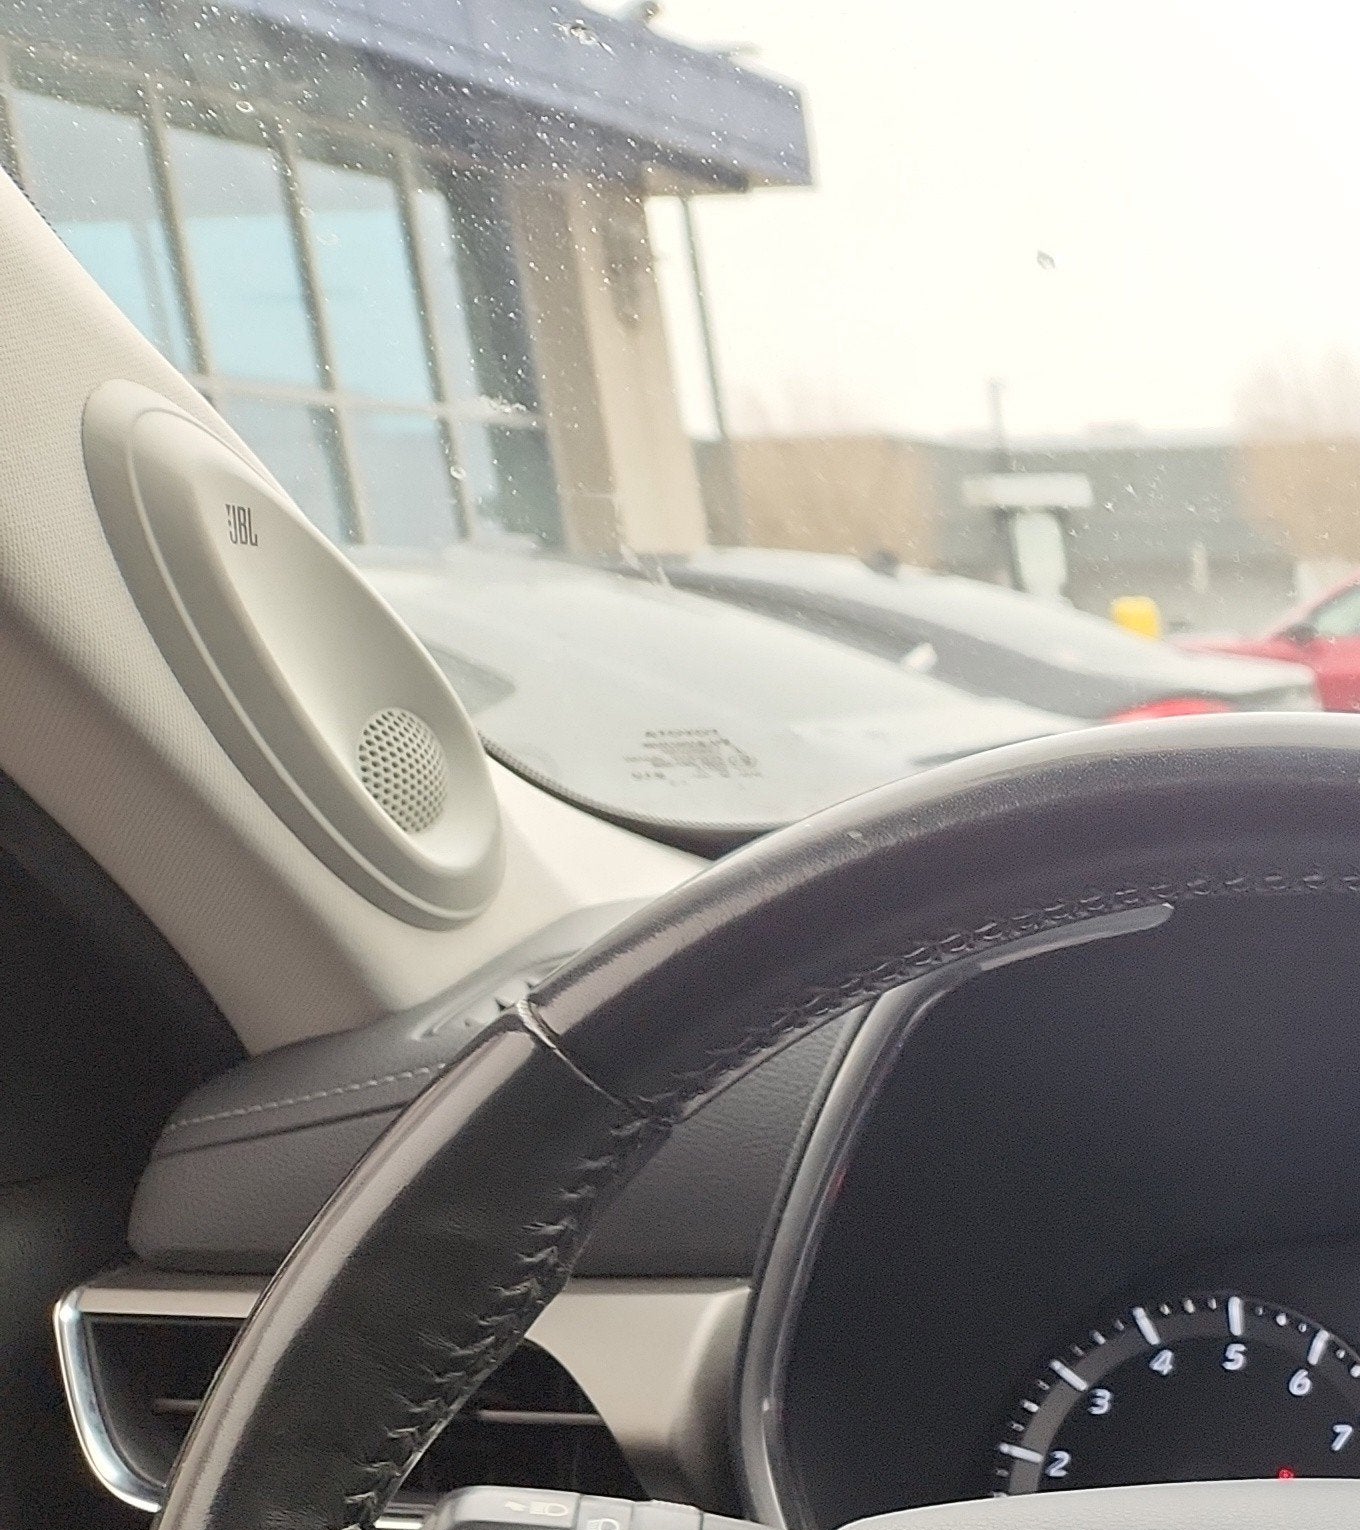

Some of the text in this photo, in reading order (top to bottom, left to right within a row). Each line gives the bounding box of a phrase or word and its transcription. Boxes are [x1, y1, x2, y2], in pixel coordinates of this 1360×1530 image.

[225, 503, 258, 547] JBL
[1150, 1349, 1174, 1375] 4
[1222, 1342, 1246, 1371] 5
[1288, 1368, 1311, 1396] 6
[1088, 1388, 1113, 1415] 3
[1331, 1424, 1353, 1452] 7
[1045, 1450, 1070, 1478] 2
